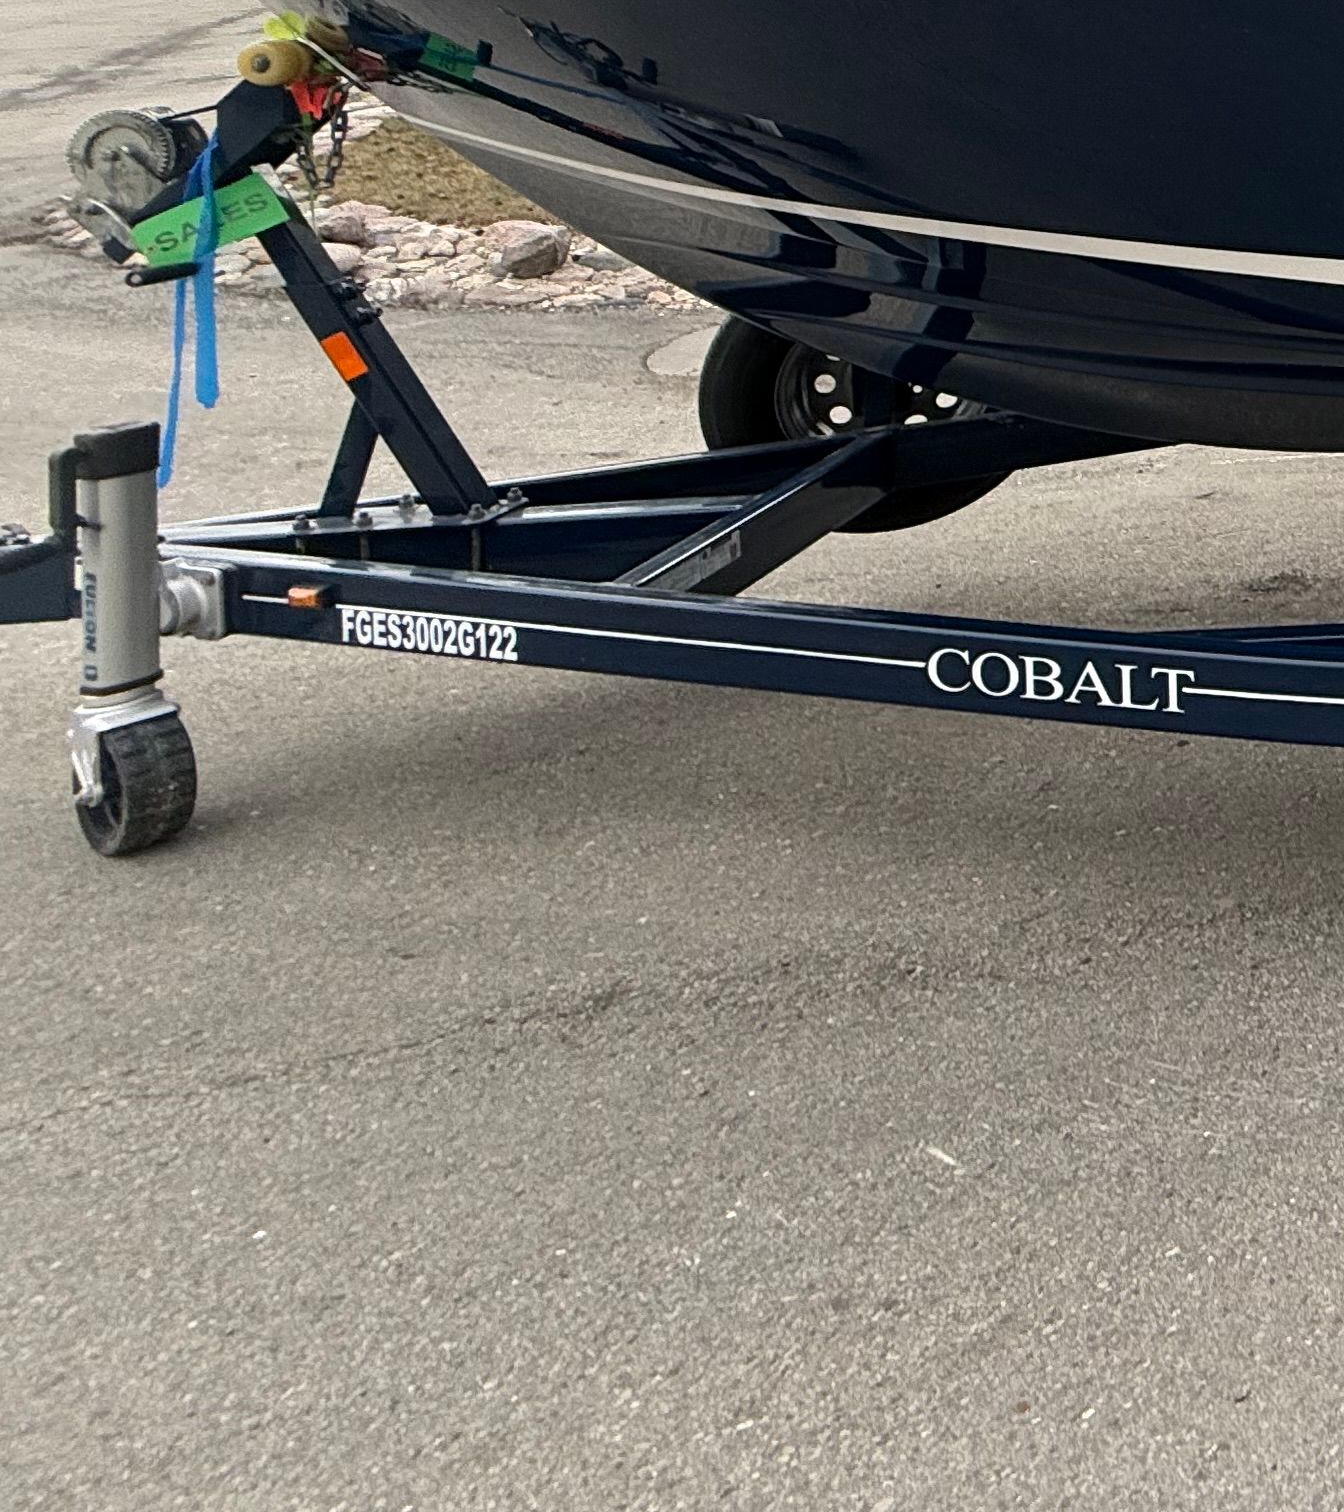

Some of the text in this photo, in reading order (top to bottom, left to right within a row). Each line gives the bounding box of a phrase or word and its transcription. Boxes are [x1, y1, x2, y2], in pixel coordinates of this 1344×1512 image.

[154, 192, 268, 252] SAES
[84, 572, 97, 653] FULTON
[341, 608, 519, 662] FGES3002G122
[926, 647, 1195, 714] COBALT
